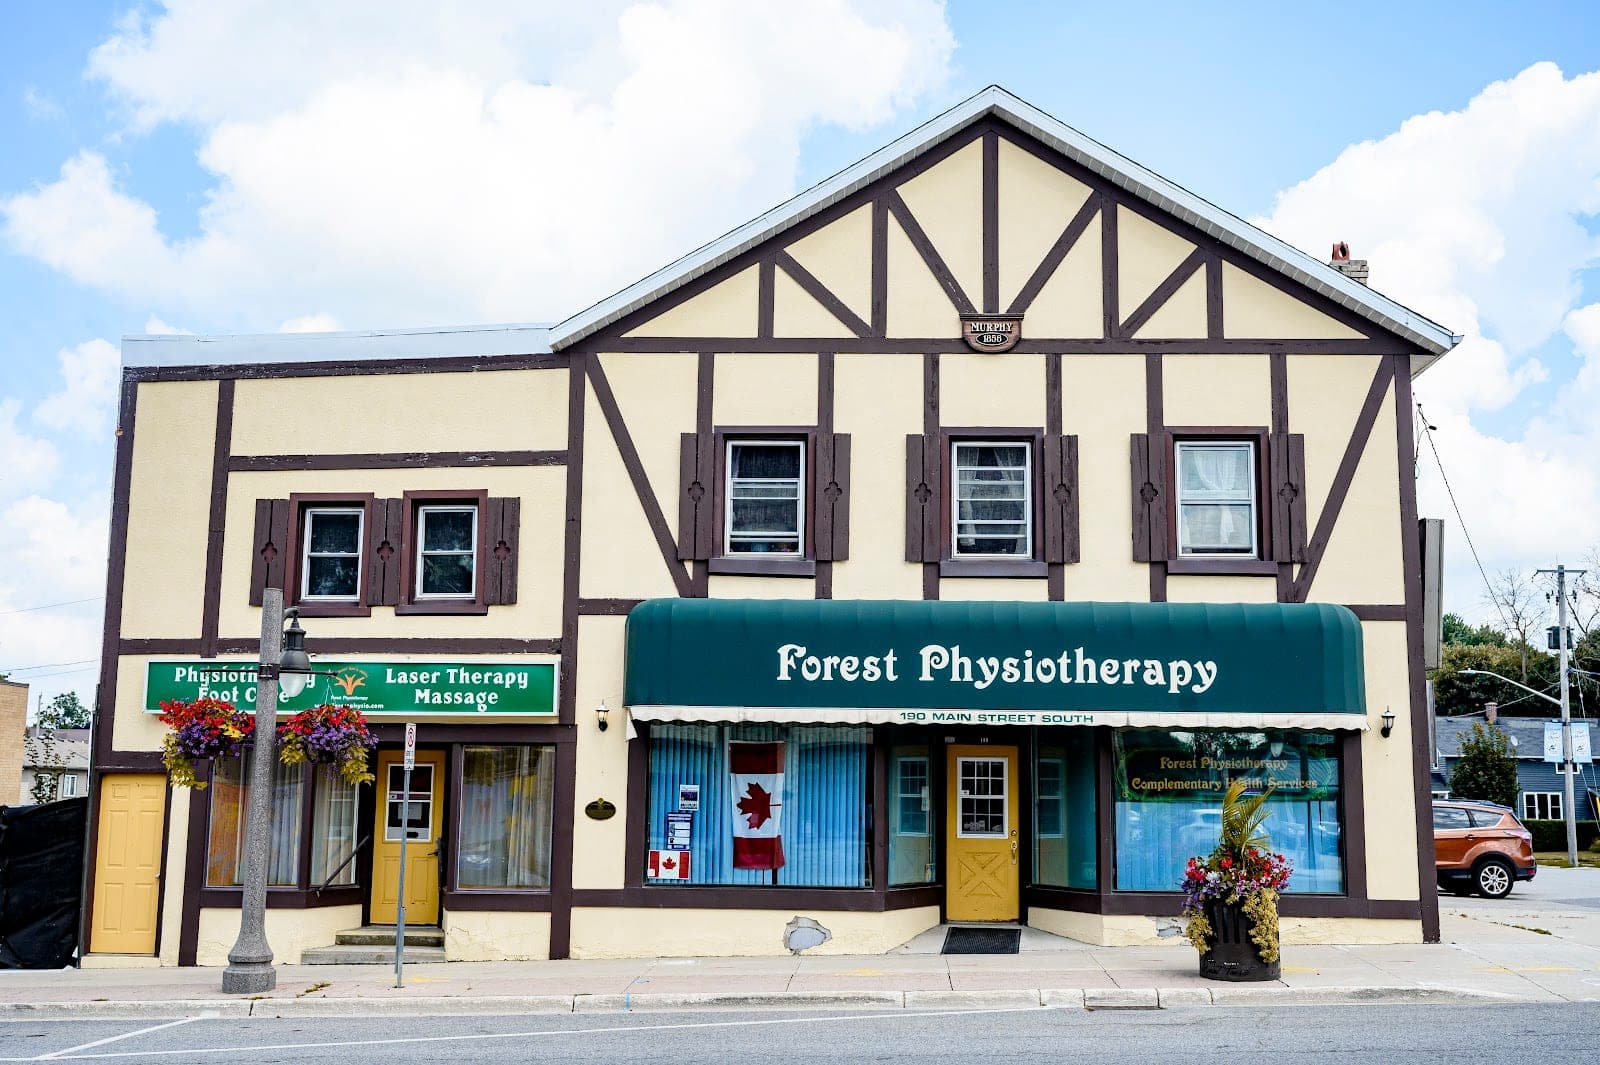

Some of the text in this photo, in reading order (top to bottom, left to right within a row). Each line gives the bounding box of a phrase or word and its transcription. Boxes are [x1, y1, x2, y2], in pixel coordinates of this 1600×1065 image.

[971, 322, 1012, 332] MURPHY
[777, 643, 1218, 694] Forest Physiotherapy
[174, 666, 316, 689] Physiothy
[385, 668, 441, 684] Laser
[446, 667, 529, 689] Therapy
[198, 686, 290, 703] Foot Ce
[414, 688, 499, 712] Massage
[900, 712, 1094, 723] 190 MAIN STREET SOUTH
[1160, 756, 1288, 771] Forest Physiotherapy
[1131, 777, 1222, 792] Complementary
[1267, 776, 1318, 789] Services
